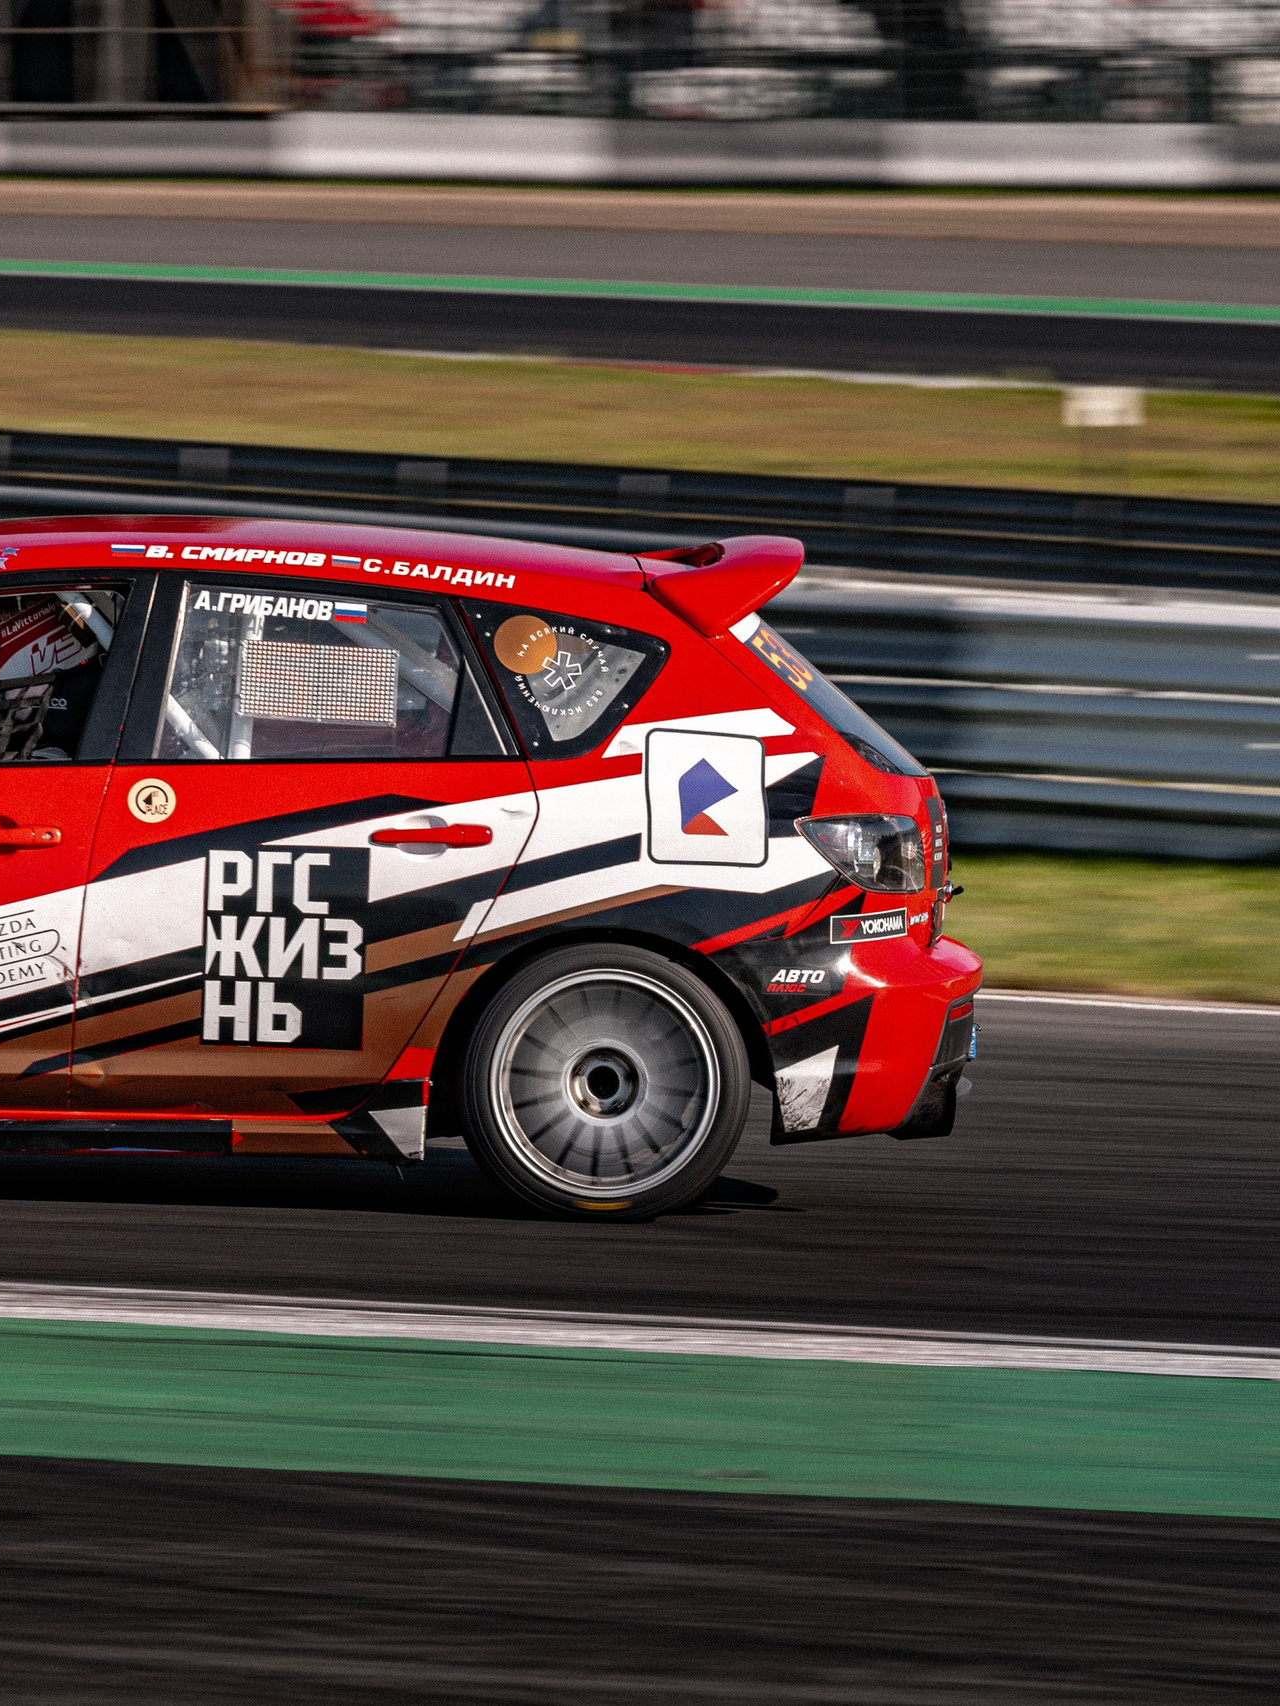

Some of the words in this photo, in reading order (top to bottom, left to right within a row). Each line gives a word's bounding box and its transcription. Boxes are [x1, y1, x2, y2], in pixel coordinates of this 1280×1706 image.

[181, 546, 326, 567] СМИРНОВ
[193, 590, 333, 622] А.ГРИБАНОВ
[530, 626, 575, 642] ВСЯКИЙ
[580, 633, 609, 674] СЛУЧАЙ
[514, 674, 583, 716] ИСКЛЮЧЕНИЙ
[586, 689, 603, 707] БЕЗ
[208, 849, 331, 915] РГС
[861, 915, 903, 935] YOKOHAMA
[205, 916, 364, 980] ЖИЗ
[766, 983, 807, 993] ПЛЮС
[771, 969, 825, 984] АВТО
[203, 980, 303, 1043] НЬ
